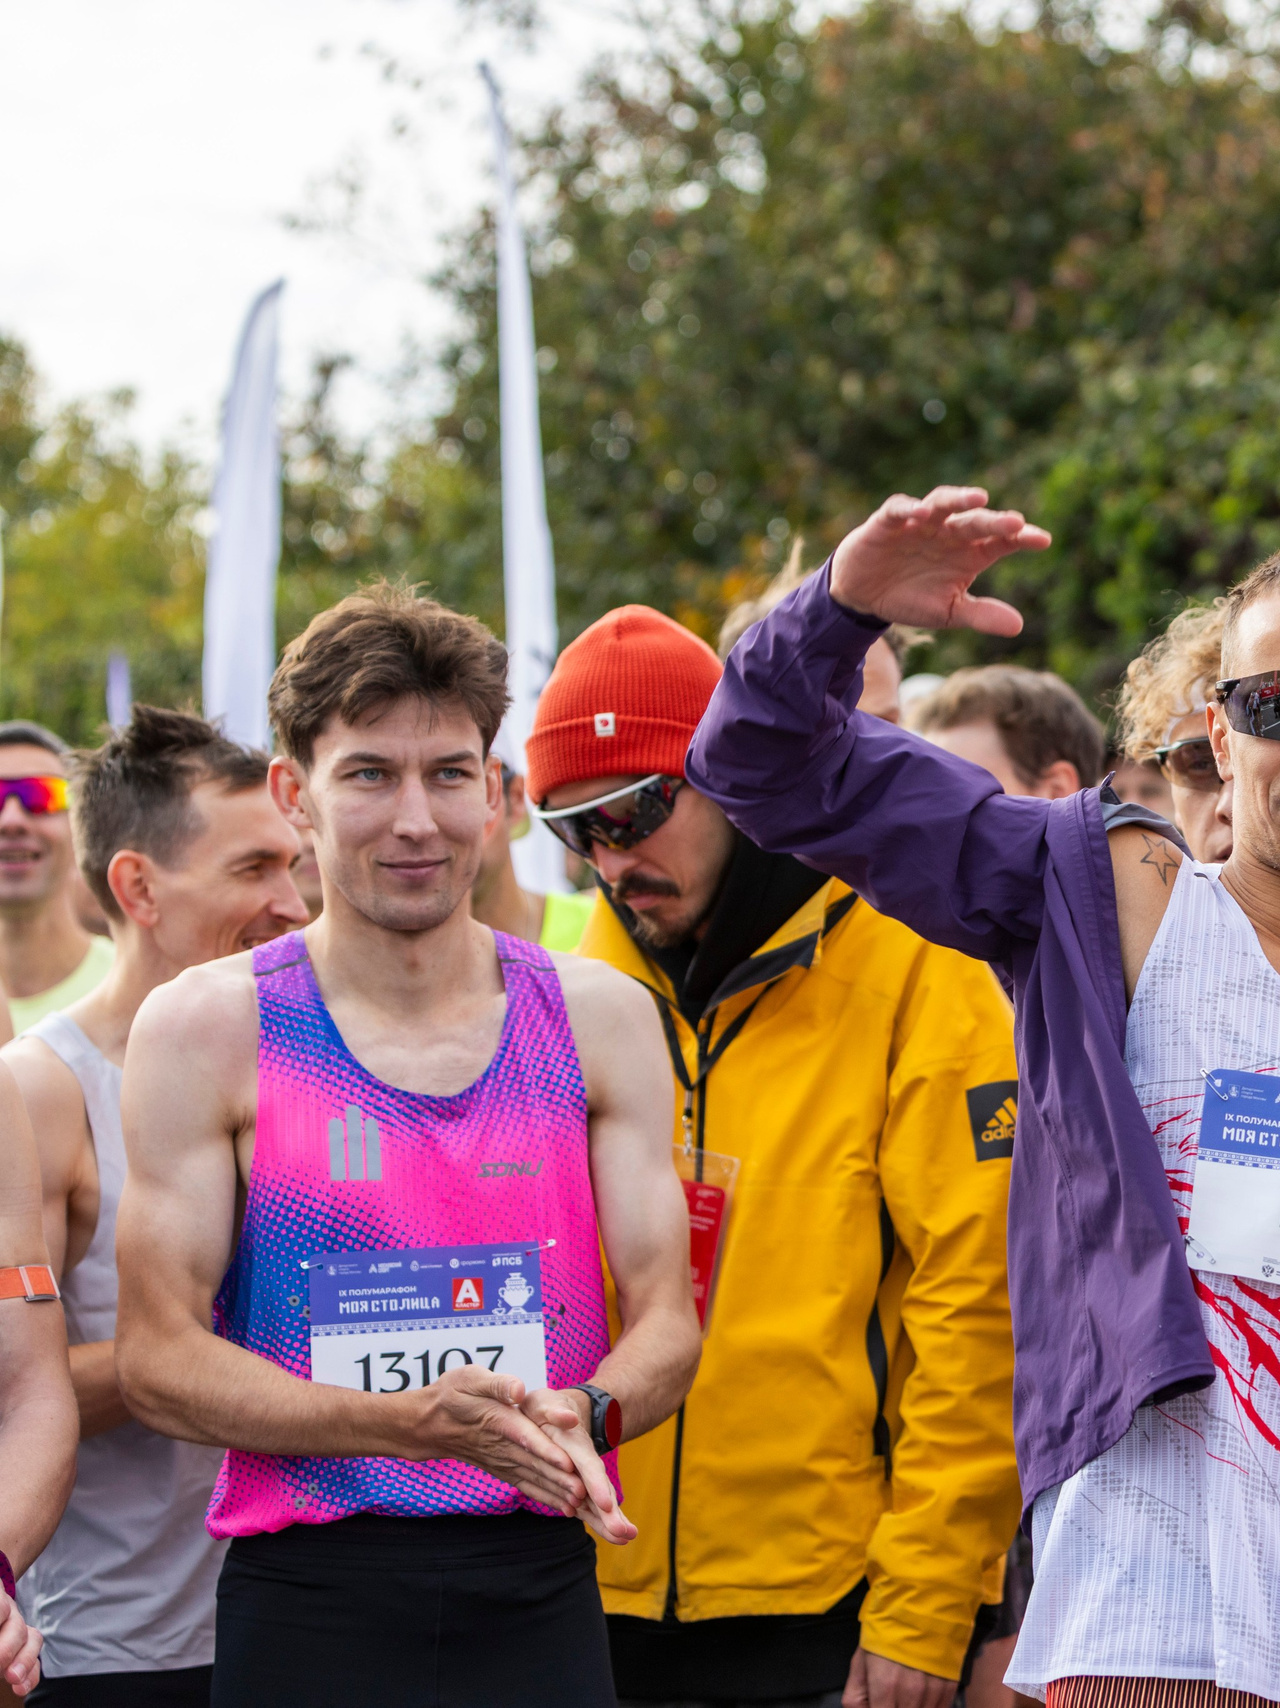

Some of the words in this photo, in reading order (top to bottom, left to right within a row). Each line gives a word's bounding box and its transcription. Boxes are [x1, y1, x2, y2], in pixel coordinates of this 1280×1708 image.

[1225, 1113, 1234, 1121] IX
[981, 1124, 1015, 1143] adi
[1222, 1126, 1256, 1144] МОЯ
[502, 1256, 522, 1266] ПСБ
[349, 1286, 417, 1296] ПОЛУМАРАФОН
[339, 1300, 368, 1314] МОЯ
[371, 1296, 440, 1312] СТОЛИЦА
